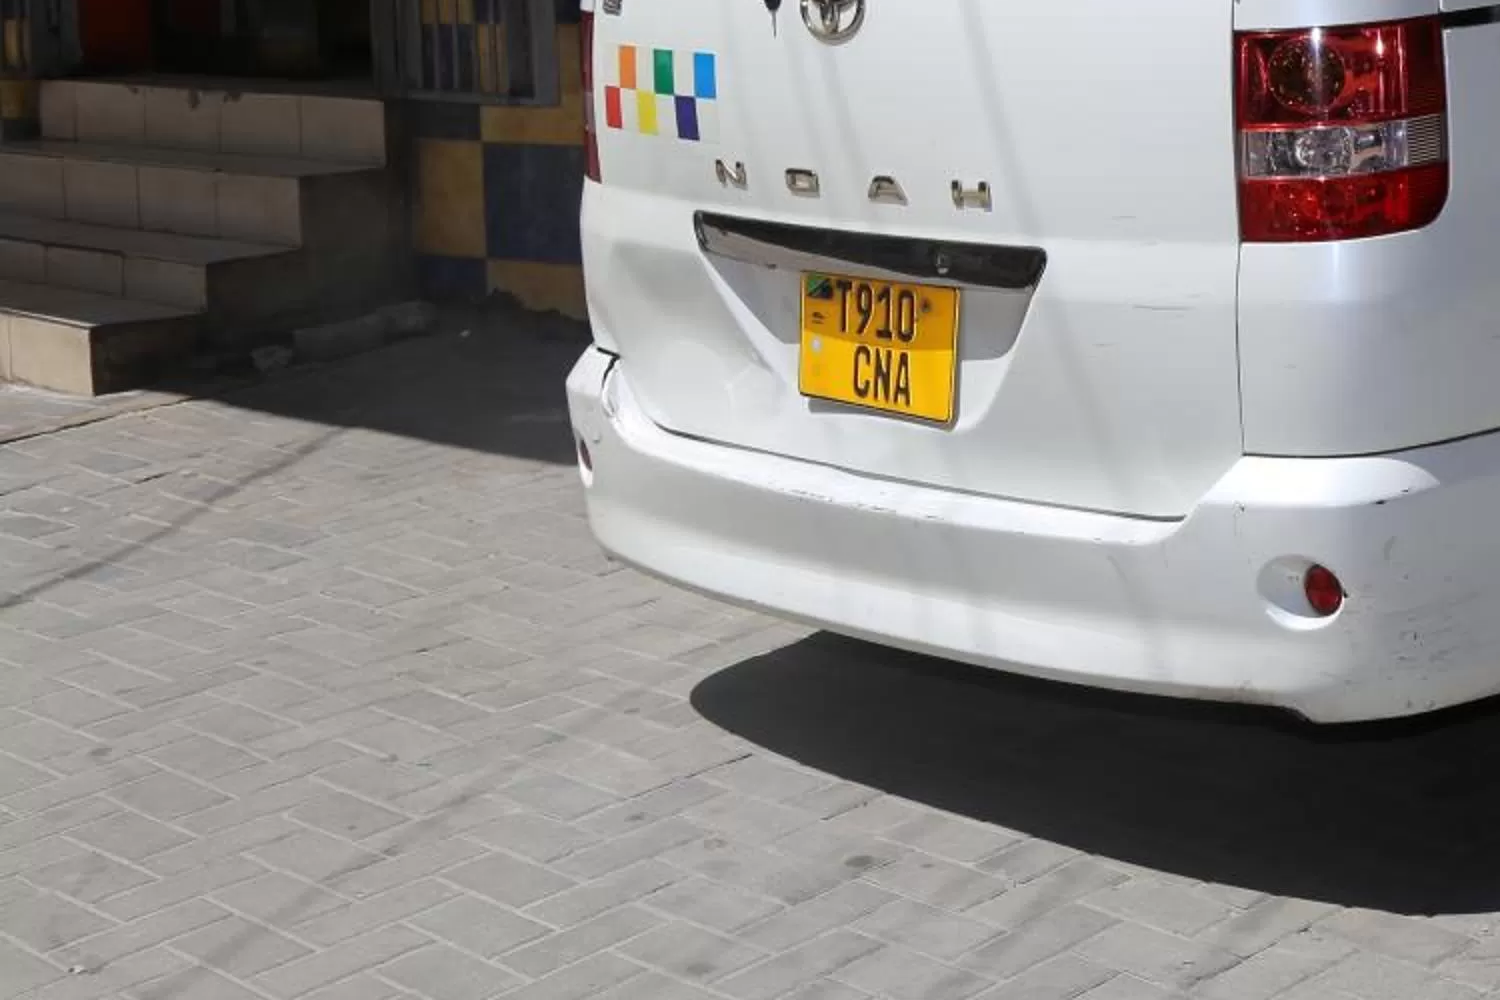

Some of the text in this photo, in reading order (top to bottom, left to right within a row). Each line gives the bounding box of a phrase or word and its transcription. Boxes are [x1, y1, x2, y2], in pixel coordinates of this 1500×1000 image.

[715, 157, 992, 212] NOAH
[835, 276, 916, 343] T910
[853, 344, 911, 407] CNA
